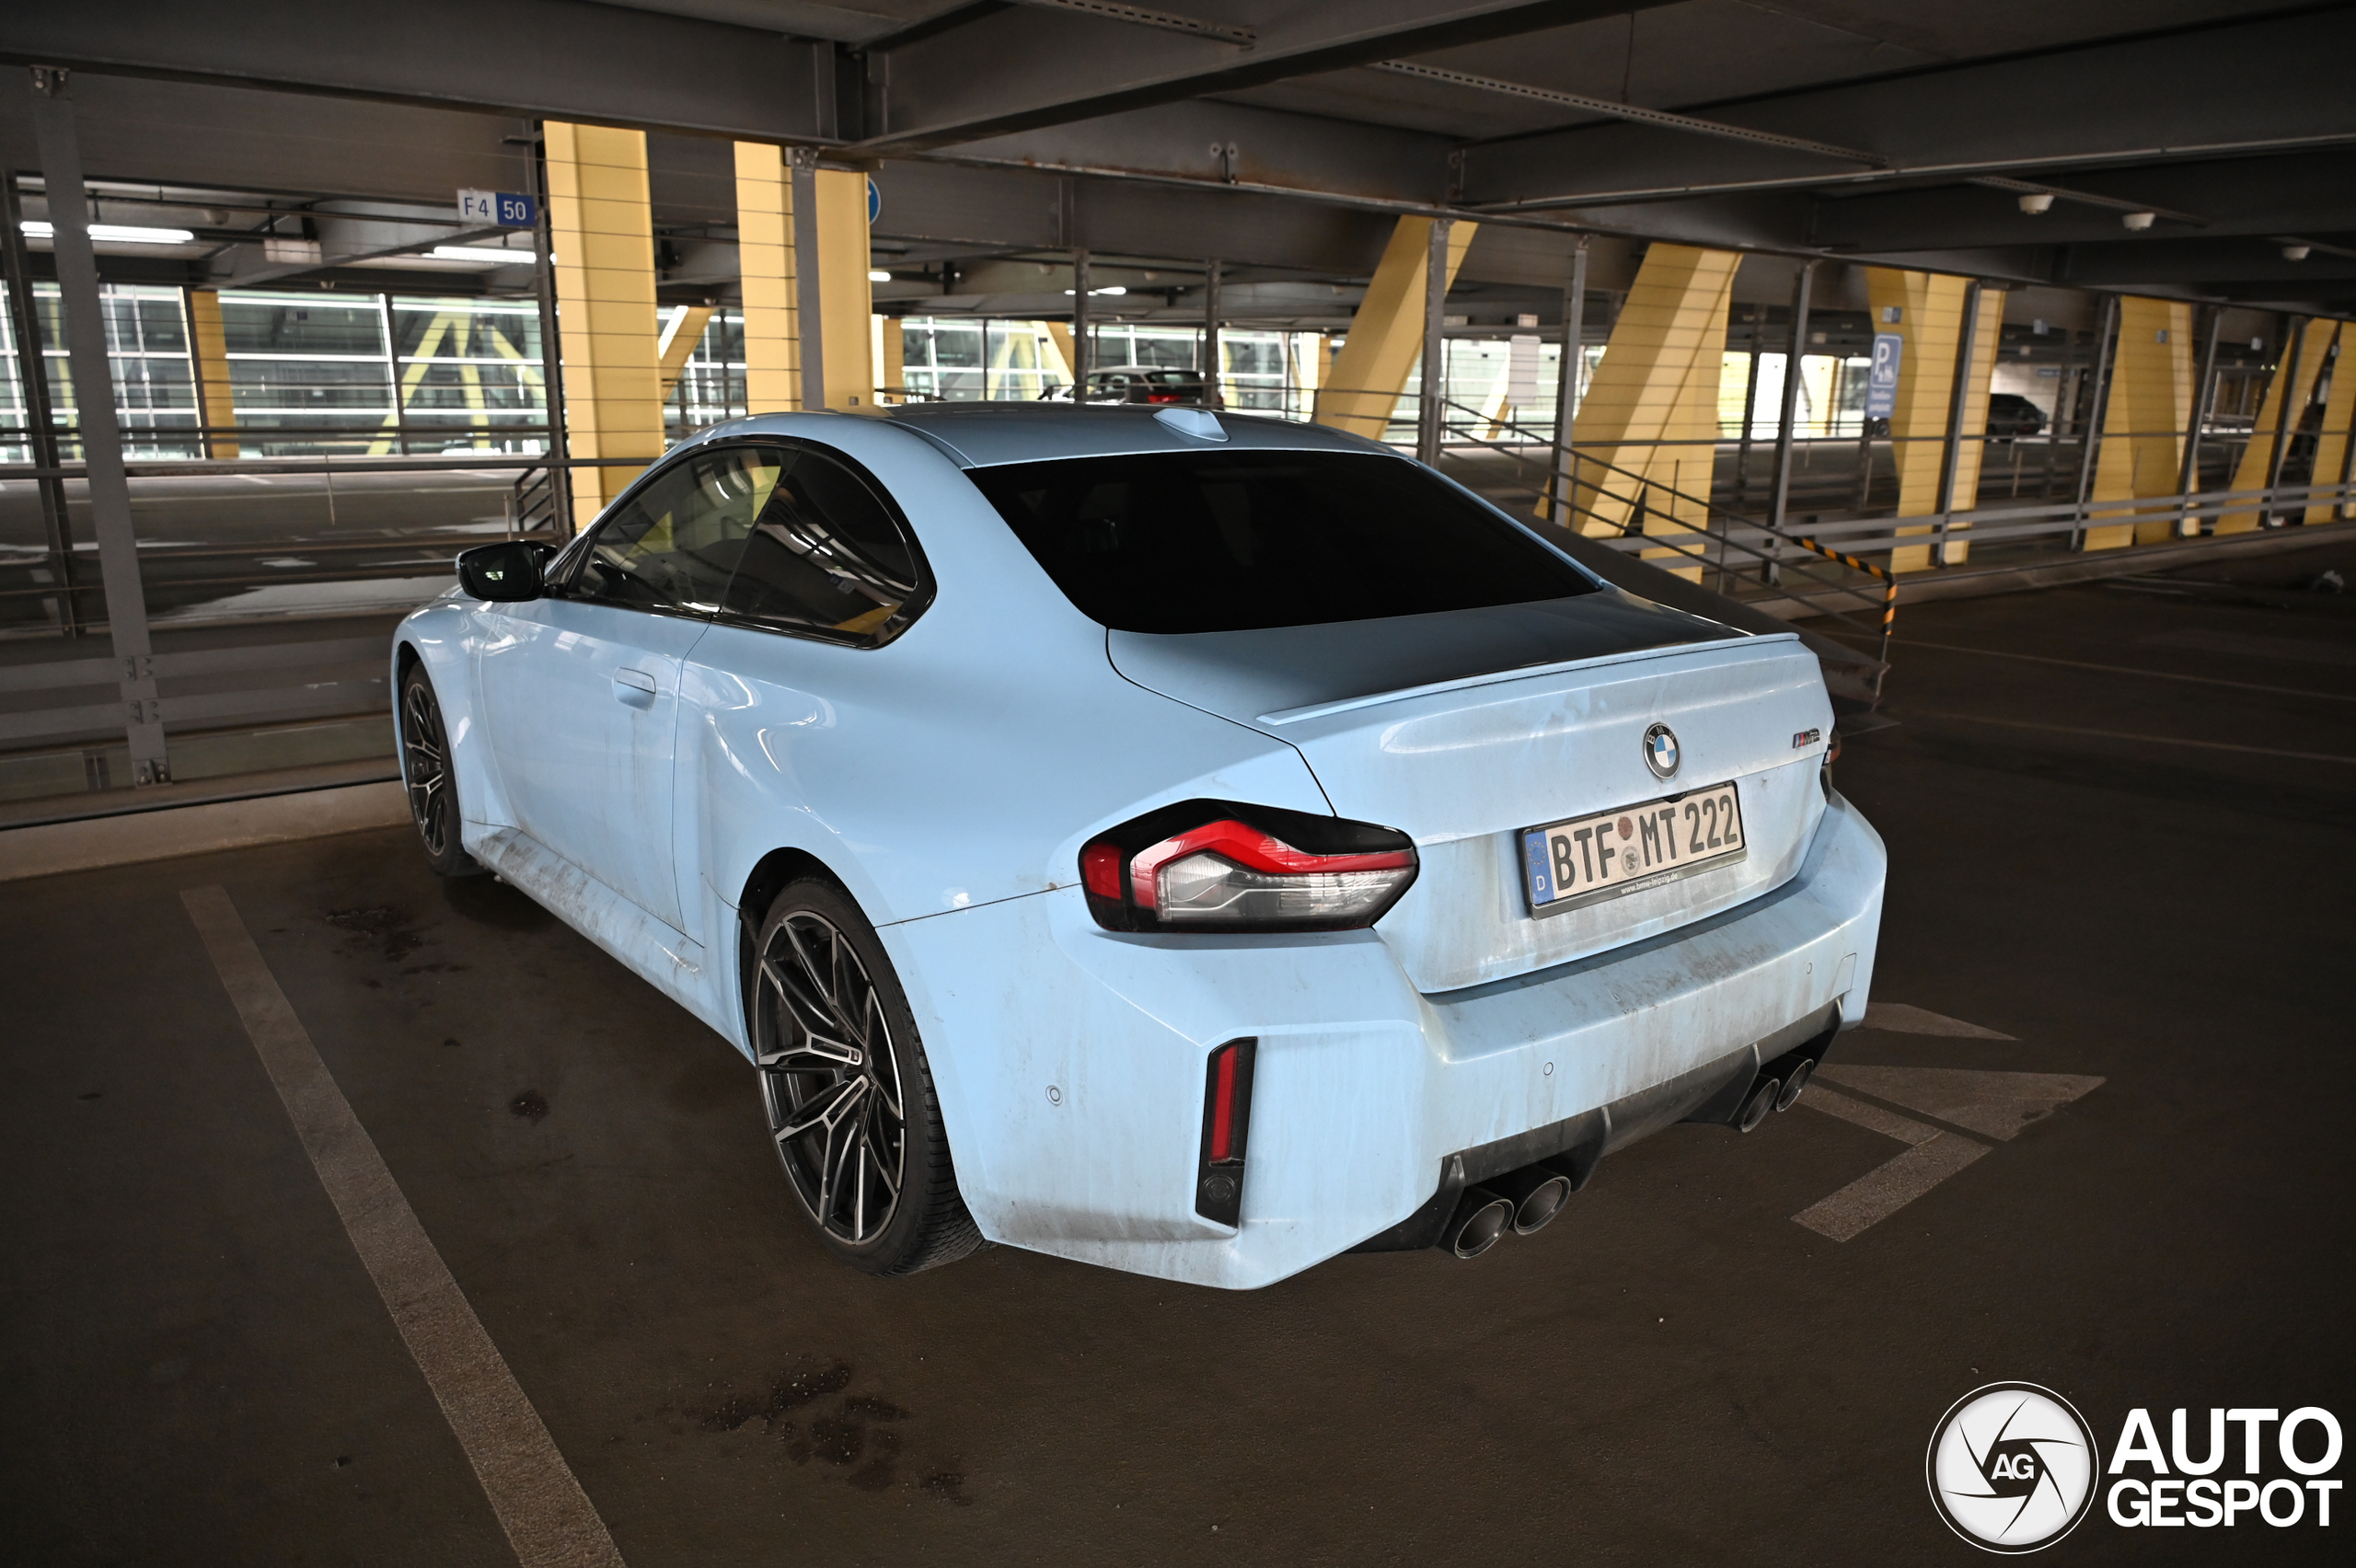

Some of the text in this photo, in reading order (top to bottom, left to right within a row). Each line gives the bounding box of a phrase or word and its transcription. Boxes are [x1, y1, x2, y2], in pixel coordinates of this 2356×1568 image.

[503, 201, 526, 220] 50
[1875, 342, 1891, 375] P
[1646, 725, 1676, 745] BMW
[1551, 794, 1738, 891] BTF MT 222
[1536, 875, 1546, 891] D
[1620, 871, 1679, 894] www.bmw-leipzig.de
